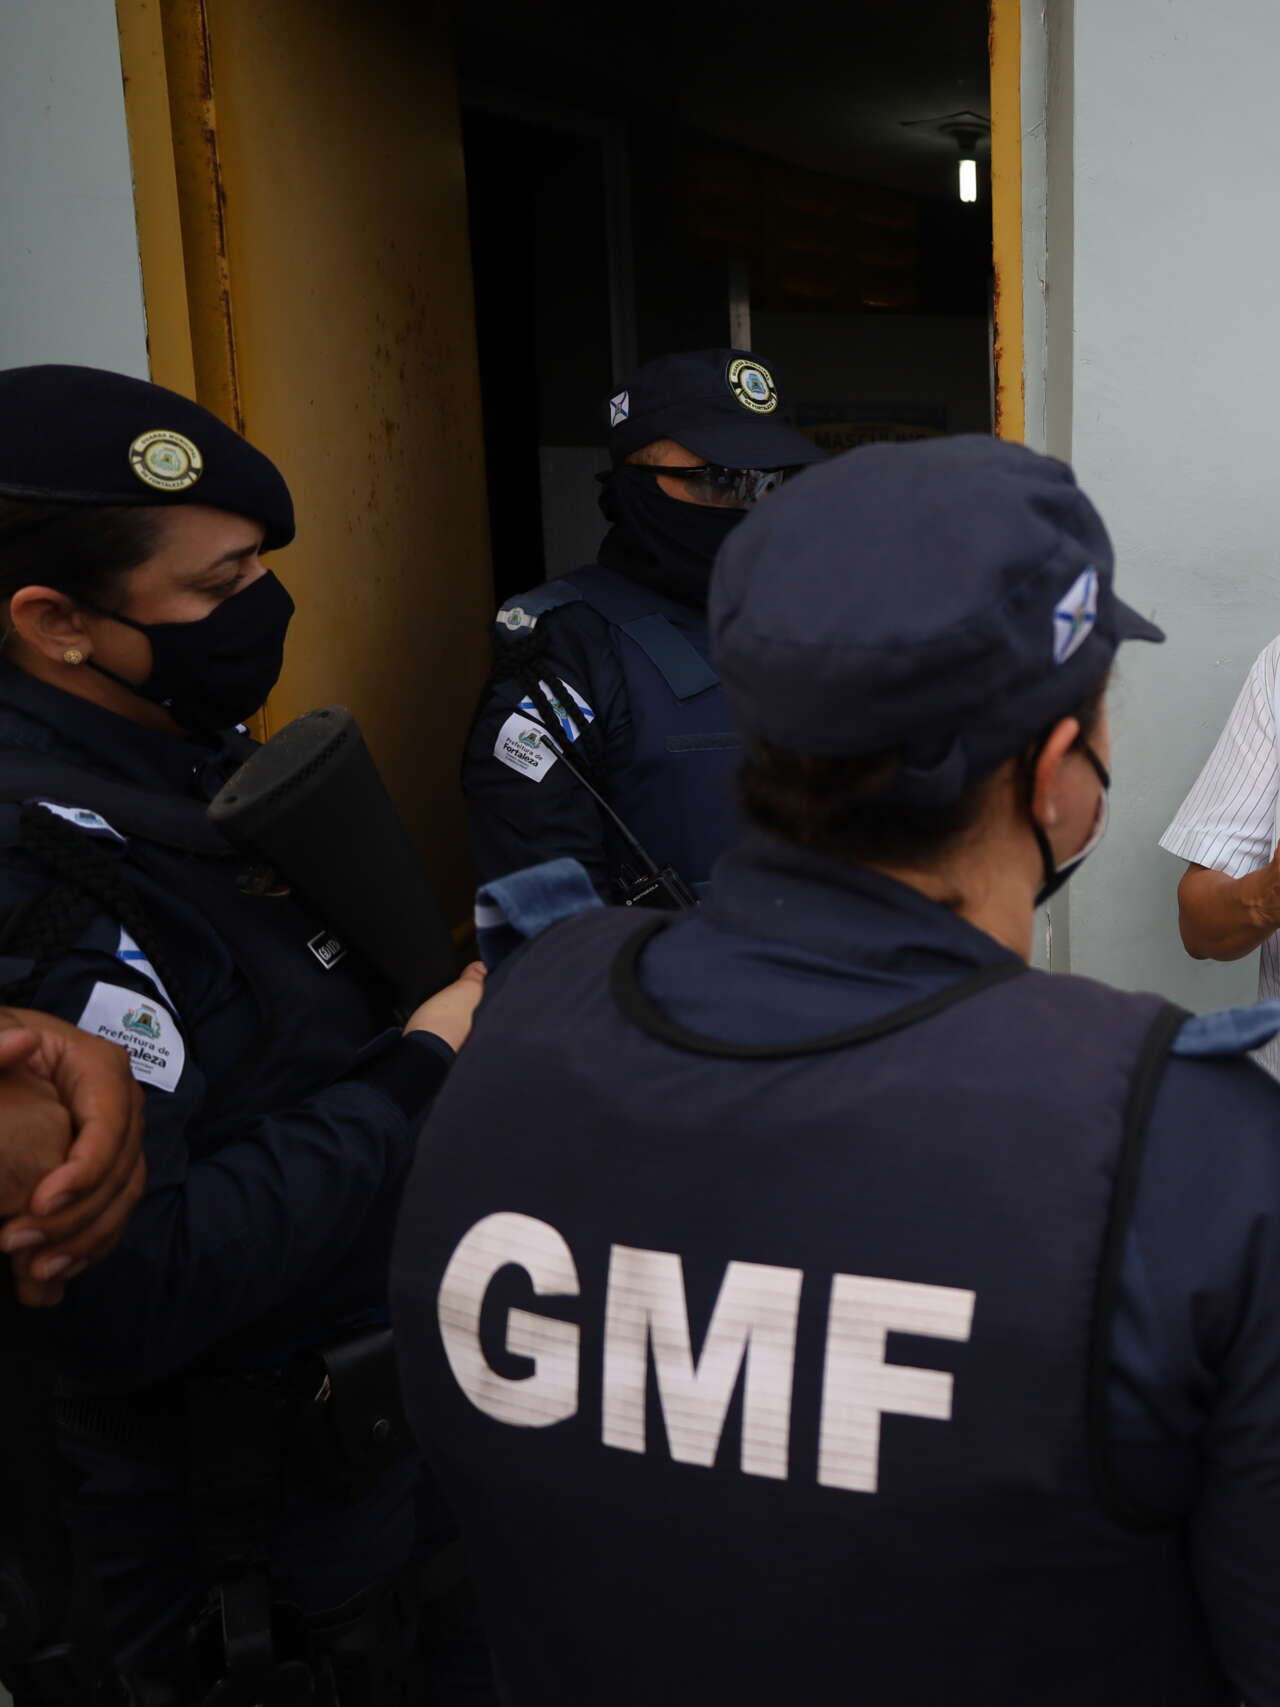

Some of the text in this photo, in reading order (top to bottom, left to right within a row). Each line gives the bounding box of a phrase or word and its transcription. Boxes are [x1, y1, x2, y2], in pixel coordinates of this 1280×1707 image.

[503, 742, 539, 768] Fortaleza
[505, 737, 534, 756] Prefeitura
[97, 1025, 171, 1057] Prefeitura de
[125, 1044, 167, 1069] taleza
[436, 1210, 976, 1495] GMF
